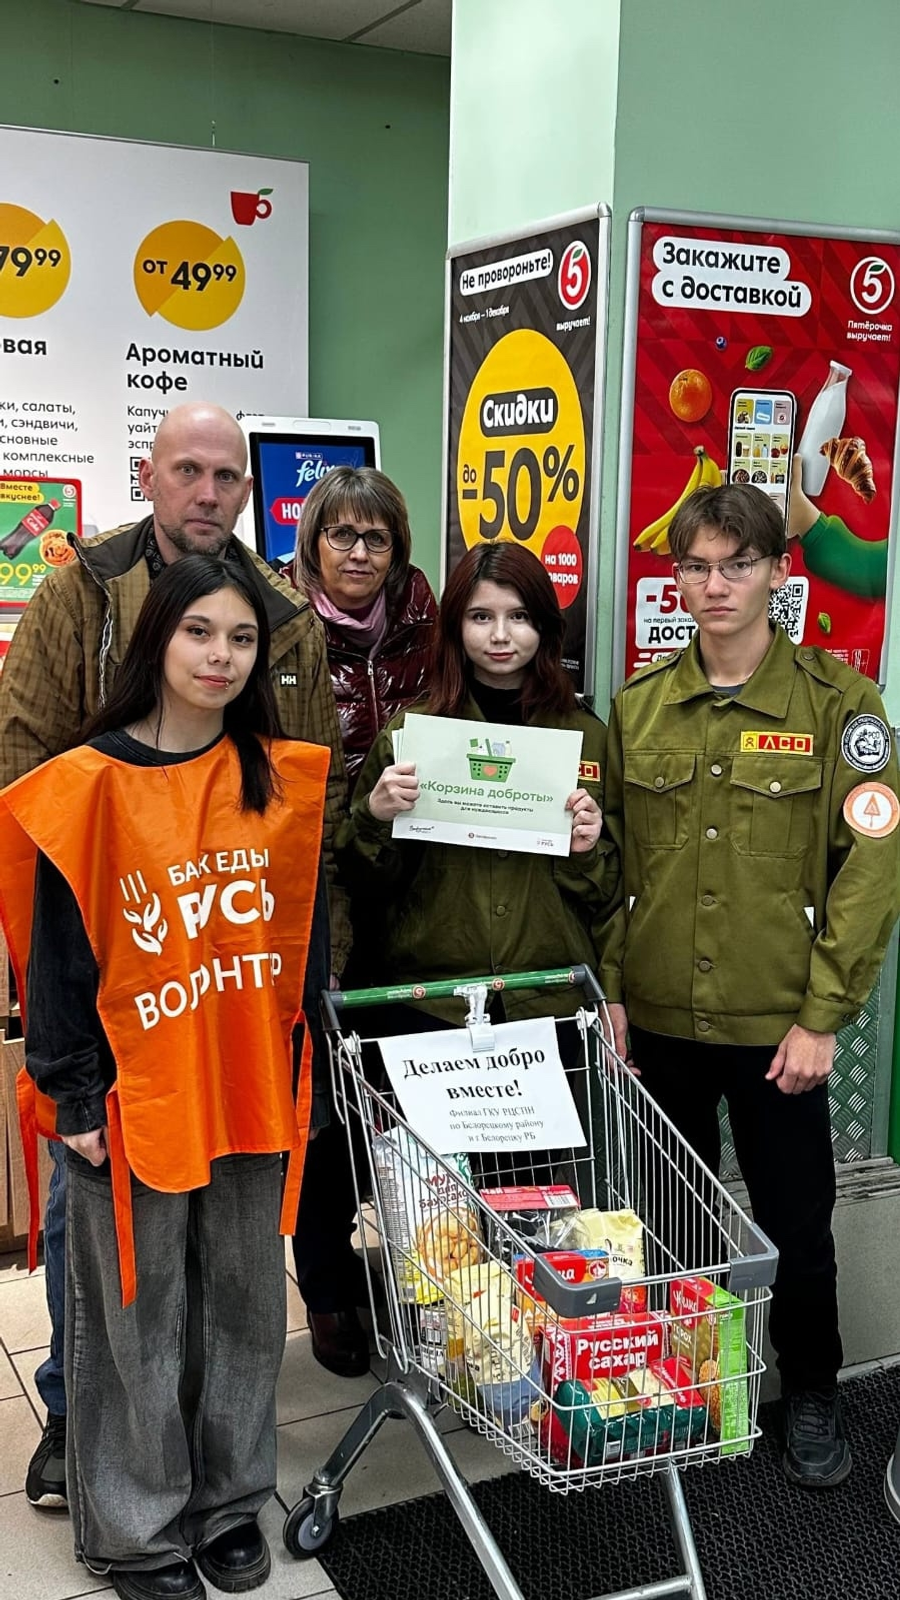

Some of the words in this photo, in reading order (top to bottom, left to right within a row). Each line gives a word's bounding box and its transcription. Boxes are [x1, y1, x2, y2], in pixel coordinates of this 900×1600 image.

[142, 259, 168, 274] от
[662, 242, 781, 274] Закажите
[462, 274, 475, 290] Не
[478, 252, 551, 288] провороньте!
[662, 279, 674, 298] с
[681, 276, 801, 308] доставкой
[861, 262, 885, 304] 5
[848, 320, 893, 332] Пятёрочка
[847, 331, 891, 343] выручает!
[0, 338, 47, 356] вая
[126, 343, 264, 369] Ароматный
[127, 371, 188, 394] кофе
[22, 402, 76, 415] салаты,
[127, 406, 168, 420] Капуч
[483, 394, 554, 428] Скидки
[11, 419, 78, 432] сэндвичи,
[3, 452, 95, 463] комплексные
[463, 464, 477, 483] до
[462, 444, 579, 541] -50%
[281, 502, 304, 520] НО
[545, 554, 557, 565] на
[558, 553, 577, 566] 1000
[653, 617, 676, 625] первый
[420, 781, 485, 797] «Корзина
[488, 788, 553, 803] доброты»
[216, 849, 269, 873] ЕДЫ
[401, 1056, 480, 1080] Делаем
[485, 1048, 545, 1070] добро
[446, 1079, 523, 1100] вместе!
[482, 1107, 500, 1116] ГКУ
[462, 1120, 513, 1131] Белорецкому
[515, 1120, 544, 1129] району
[481, 1133, 522, 1143] Белорецку
[524, 1131, 536, 1140] РБ
[577, 1330, 658, 1357] Русский
[589, 1351, 646, 1370] сахар
